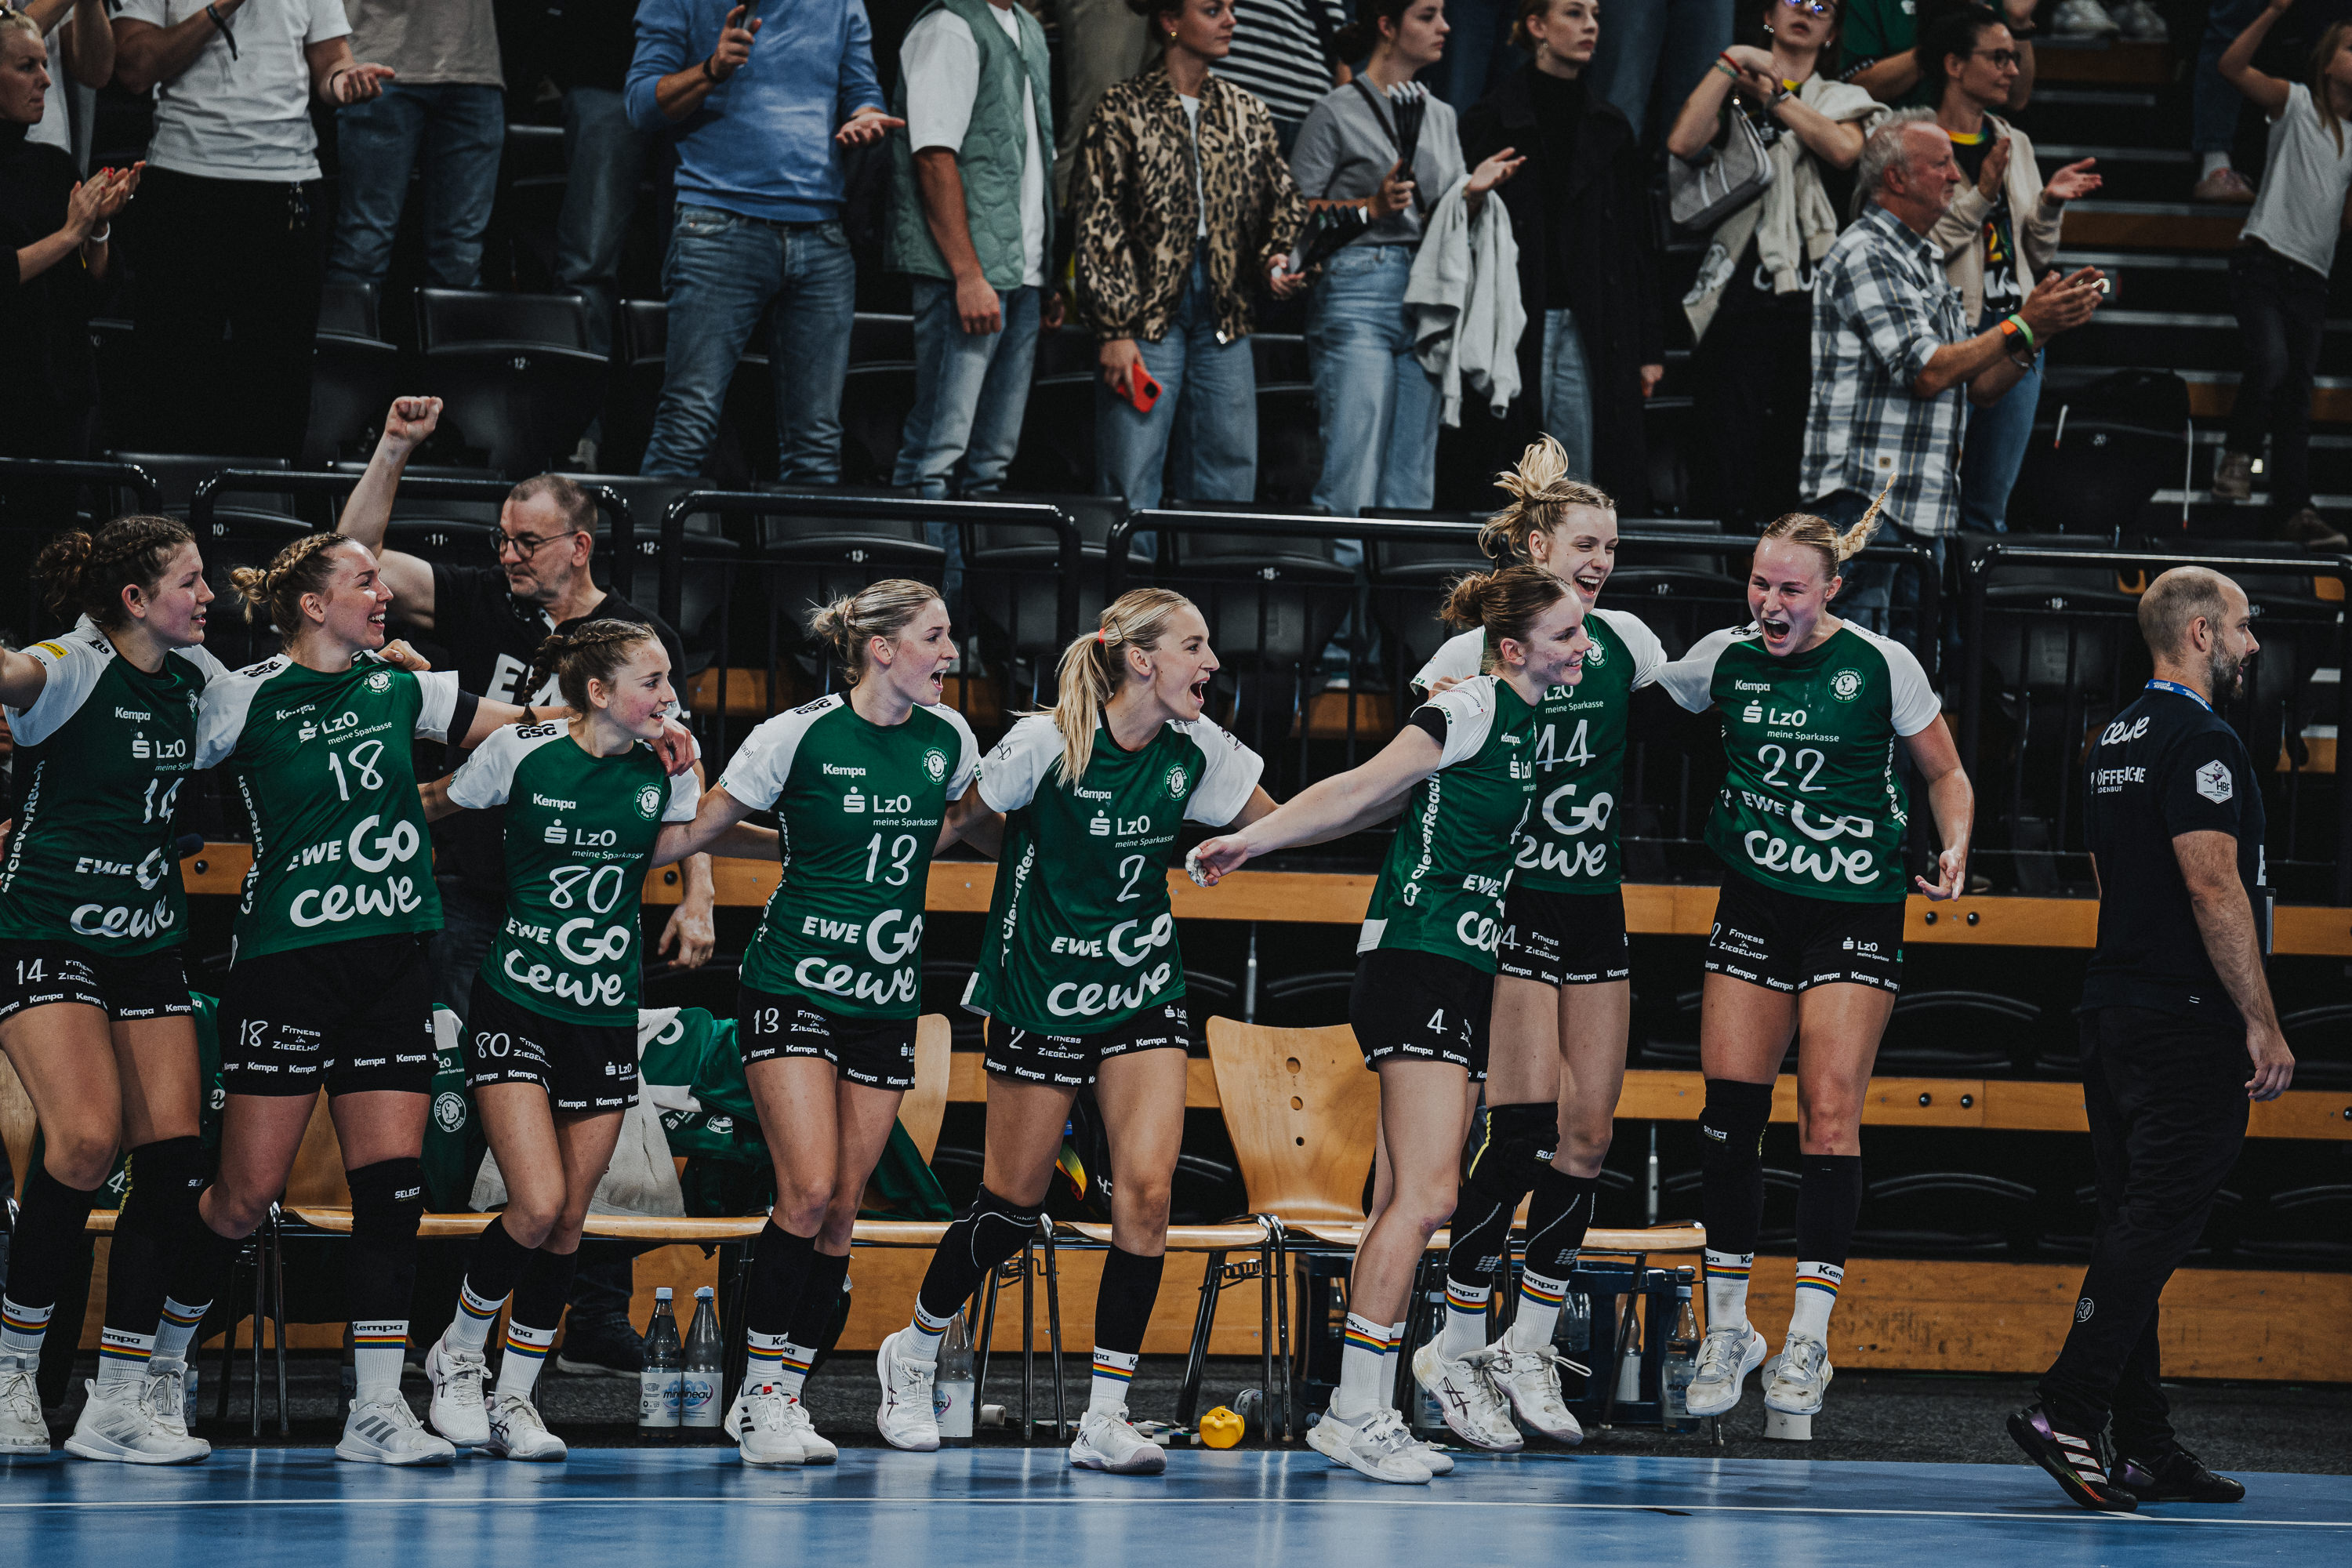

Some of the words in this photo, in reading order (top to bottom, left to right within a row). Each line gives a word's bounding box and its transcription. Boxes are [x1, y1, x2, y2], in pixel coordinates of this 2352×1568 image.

[514, 357, 527, 370] 12
[212, 523, 224, 536] 10
[431, 533, 444, 546] 11
[643, 541, 655, 555] 12
[1657, 583, 1670, 596] 17
[1838, 670, 1862, 684] Oldenburg
[1735, 679, 1771, 694] Kempa
[115, 706, 151, 723] Kempa
[1545, 704, 1566, 714] meine
[1568, 700, 1604, 712] Sparkasse
[321, 711, 359, 735] LzO
[1769, 708, 1808, 727] LzO
[328, 732, 354, 746] meine
[354, 720, 393, 738] Sparkasse
[517, 726, 558, 739] GSG
[1767, 730, 1794, 740] meine
[1795, 731, 1839, 743] Sparkasse
[156, 739, 187, 759] LzO
[1535, 719, 1596, 772] 44
[155, 764, 177, 772] meine
[328, 739, 385, 801] 18
[822, 763, 866, 778] Kempa
[1758, 744, 1827, 792] 22
[1073, 786, 1112, 802] Kempa
[2216, 782, 2230, 792] HBF
[533, 793, 576, 811] Kempa
[873, 795, 912, 813] LzO
[1541, 784, 1614, 836] Go
[873, 818, 900, 826] meine
[901, 818, 938, 828] Sparkasse
[1741, 790, 1787, 817] EWE
[1791, 800, 1874, 841] Go
[1117, 815, 1150, 836] LzO
[348, 814, 419, 873] Go
[575, 829, 617, 847] LzO
[1115, 837, 1138, 848] meine
[1140, 833, 1174, 847] Sparkasse
[572, 849, 601, 859] meine
[602, 851, 644, 860] Sparkasse
[866, 833, 917, 886] 13
[1744, 829, 1880, 884] cewe
[1116, 855, 1146, 902] 2
[1462, 874, 1503, 898] EWE
[549, 865, 625, 914] 80
[289, 876, 422, 927] cewe
[506, 917, 552, 945] EWE
[555, 916, 630, 965] Go
[801, 916, 862, 944] EWE
[866, 909, 924, 964] Go
[1051, 937, 1103, 958] EWE
[1108, 913, 1173, 967] Go
[1532, 932, 1559, 946] FITNESS
[1730, 928, 1765, 945] FITNESS
[1525, 946, 1560, 962] ZIEGELHOF
[1719, 942, 1769, 960] ZIEGELHOF
[1857, 940, 1878, 952] LzO
[16, 957, 49, 985] 14
[1501, 963, 1532, 976] Kempa
[1566, 972, 1597, 982] Kempa
[1607, 967, 1629, 978] Kempa
[1726, 964, 1758, 981] Kempa
[1766, 977, 1794, 991] Kempa
[1813, 971, 1841, 982] Kempa
[1851, 971, 1879, 984] Kempa
[504, 949, 626, 1007] cewe
[795, 957, 916, 1004] cewe
[1047, 962, 1171, 1017] cewe
[29, 993, 64, 1004] Kempa
[76, 992, 101, 1005] Kempa
[120, 1007, 154, 1017] Kempa
[165, 1004, 192, 1013] Kempa
[1177, 1007, 1188, 1018] LzO
[753, 1007, 779, 1035] 13
[1427, 1008, 1448, 1035] 4
[239, 1018, 268, 1047] 18
[282, 1025, 321, 1036] FITNESS
[475, 1032, 510, 1058] 80
[1047, 1035, 1081, 1044] FITNESS
[1101, 1043, 1127, 1055] Kempa
[1136, 1036, 1167, 1047] Kempa
[751, 1047, 775, 1058] Kempa
[786, 1044, 818, 1054] Kempa
[1037, 1047, 1085, 1060] ZIEGELHOF
[1373, 1045, 1393, 1057] Kempa
[1403, 1043, 1433, 1056] Kempa
[1443, 1050, 1468, 1065] Kempa
[247, 1062, 278, 1073] Kempa
[289, 1063, 317, 1075] Kempa
[354, 1057, 386, 1068] Kempa
[396, 1054, 427, 1063] Kempa
[439, 1058, 452, 1069] zO
[476, 1072, 499, 1083] Kempa
[508, 1069, 538, 1080] Kempa
[619, 1064, 633, 1075] LzO
[986, 1058, 1007, 1072] Kempa
[1014, 1066, 1045, 1080] Kempa
[1054, 1073, 1082, 1085] Kempa
[848, 1068, 878, 1083] Kempa
[887, 1076, 909, 1088] Kempa
[558, 1099, 587, 1109] Kempa
[596, 1097, 623, 1108] Kempa
[1704, 1125, 1728, 1140] SELECT
[394, 1186, 421, 1200] SELECT
[352, 1323, 403, 1334] Kempa
[101, 1333, 141, 1345] empa
